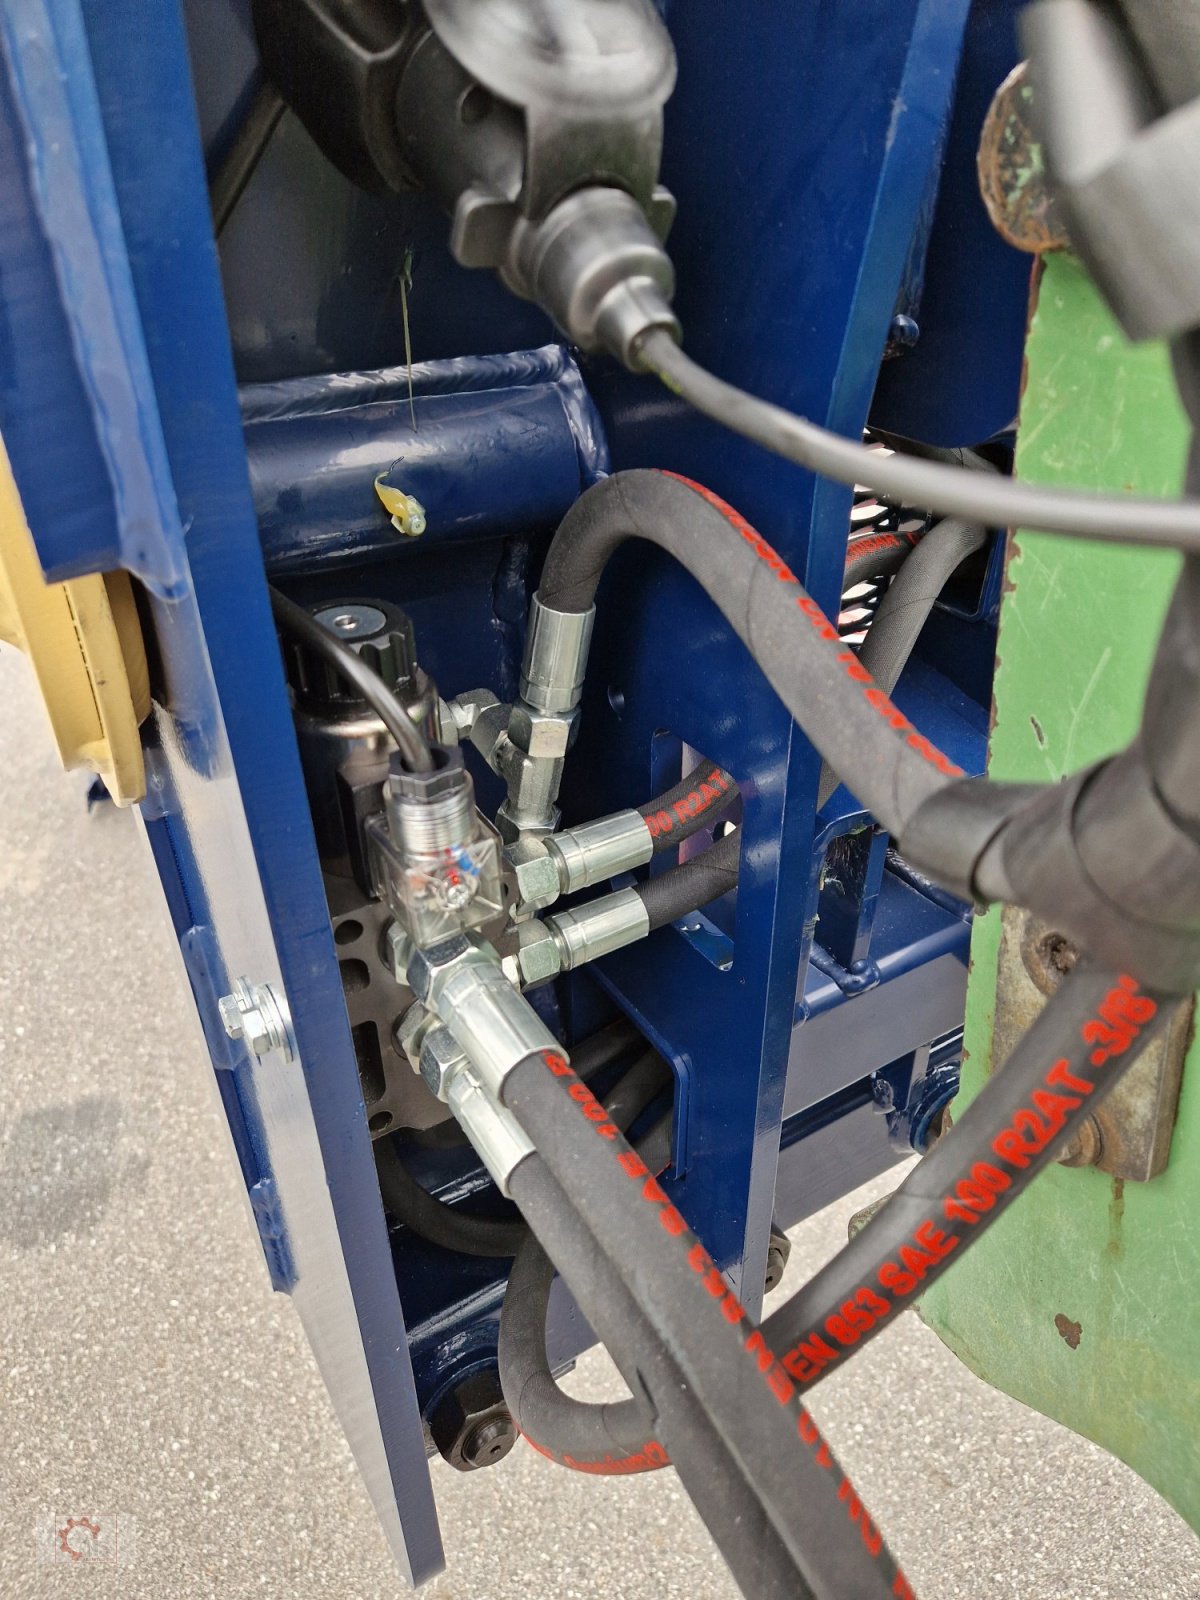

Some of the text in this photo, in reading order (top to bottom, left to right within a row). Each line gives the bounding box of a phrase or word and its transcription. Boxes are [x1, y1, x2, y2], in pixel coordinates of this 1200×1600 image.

[673, 768, 729, 824] R2AT
[617, 1151, 688, 1237] SAE
[785, 1334, 840, 1384] EN
[823, 1287, 892, 1345] 853
[877, 1220, 960, 1296] SAE
[944, 1161, 1012, 1225] 100
[992, 1058, 1096, 1169] R2AT
[688, 1244, 746, 1324] 853
